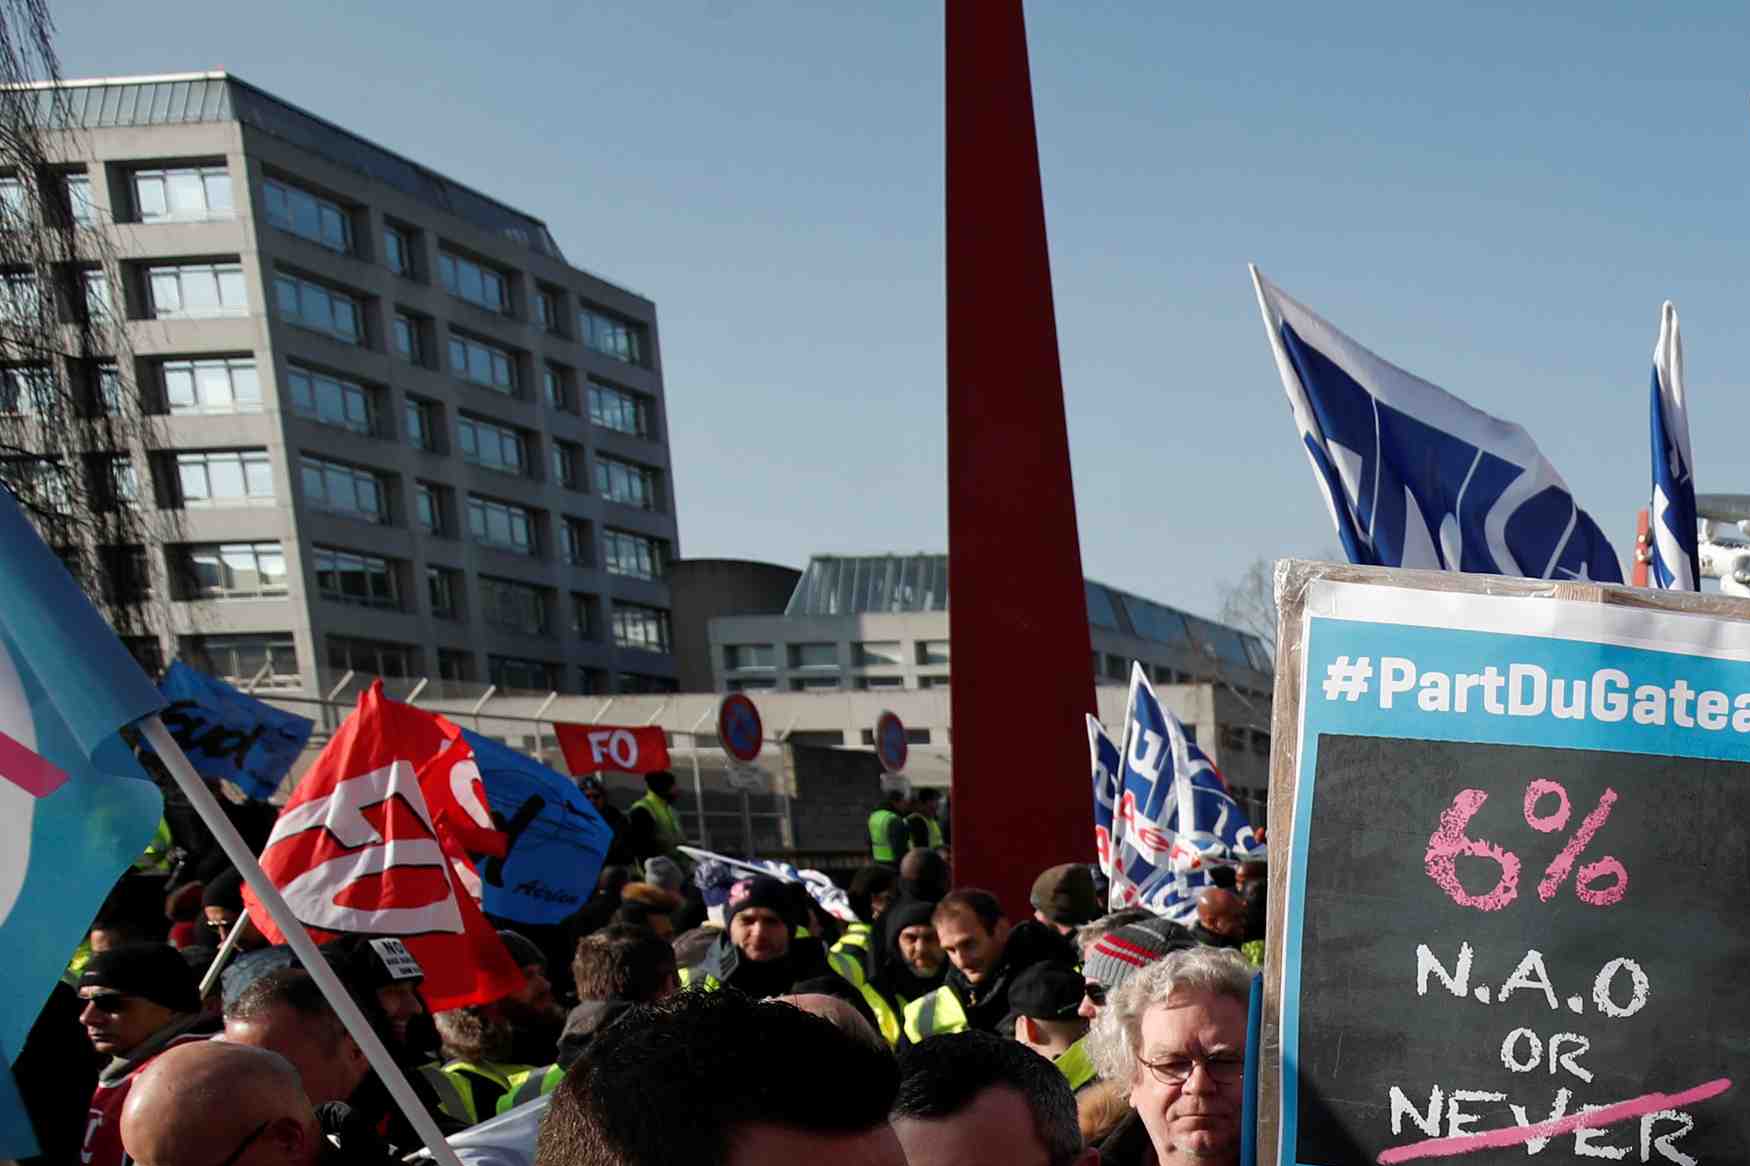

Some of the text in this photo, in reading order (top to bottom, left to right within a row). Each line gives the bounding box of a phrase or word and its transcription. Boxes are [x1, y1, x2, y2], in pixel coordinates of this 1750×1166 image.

[587, 729, 638, 769] FO
[1424, 778, 1630, 911] 6%
[1415, 940, 1651, 1018] N.A.O
[1499, 1027, 1594, 1084] OR
